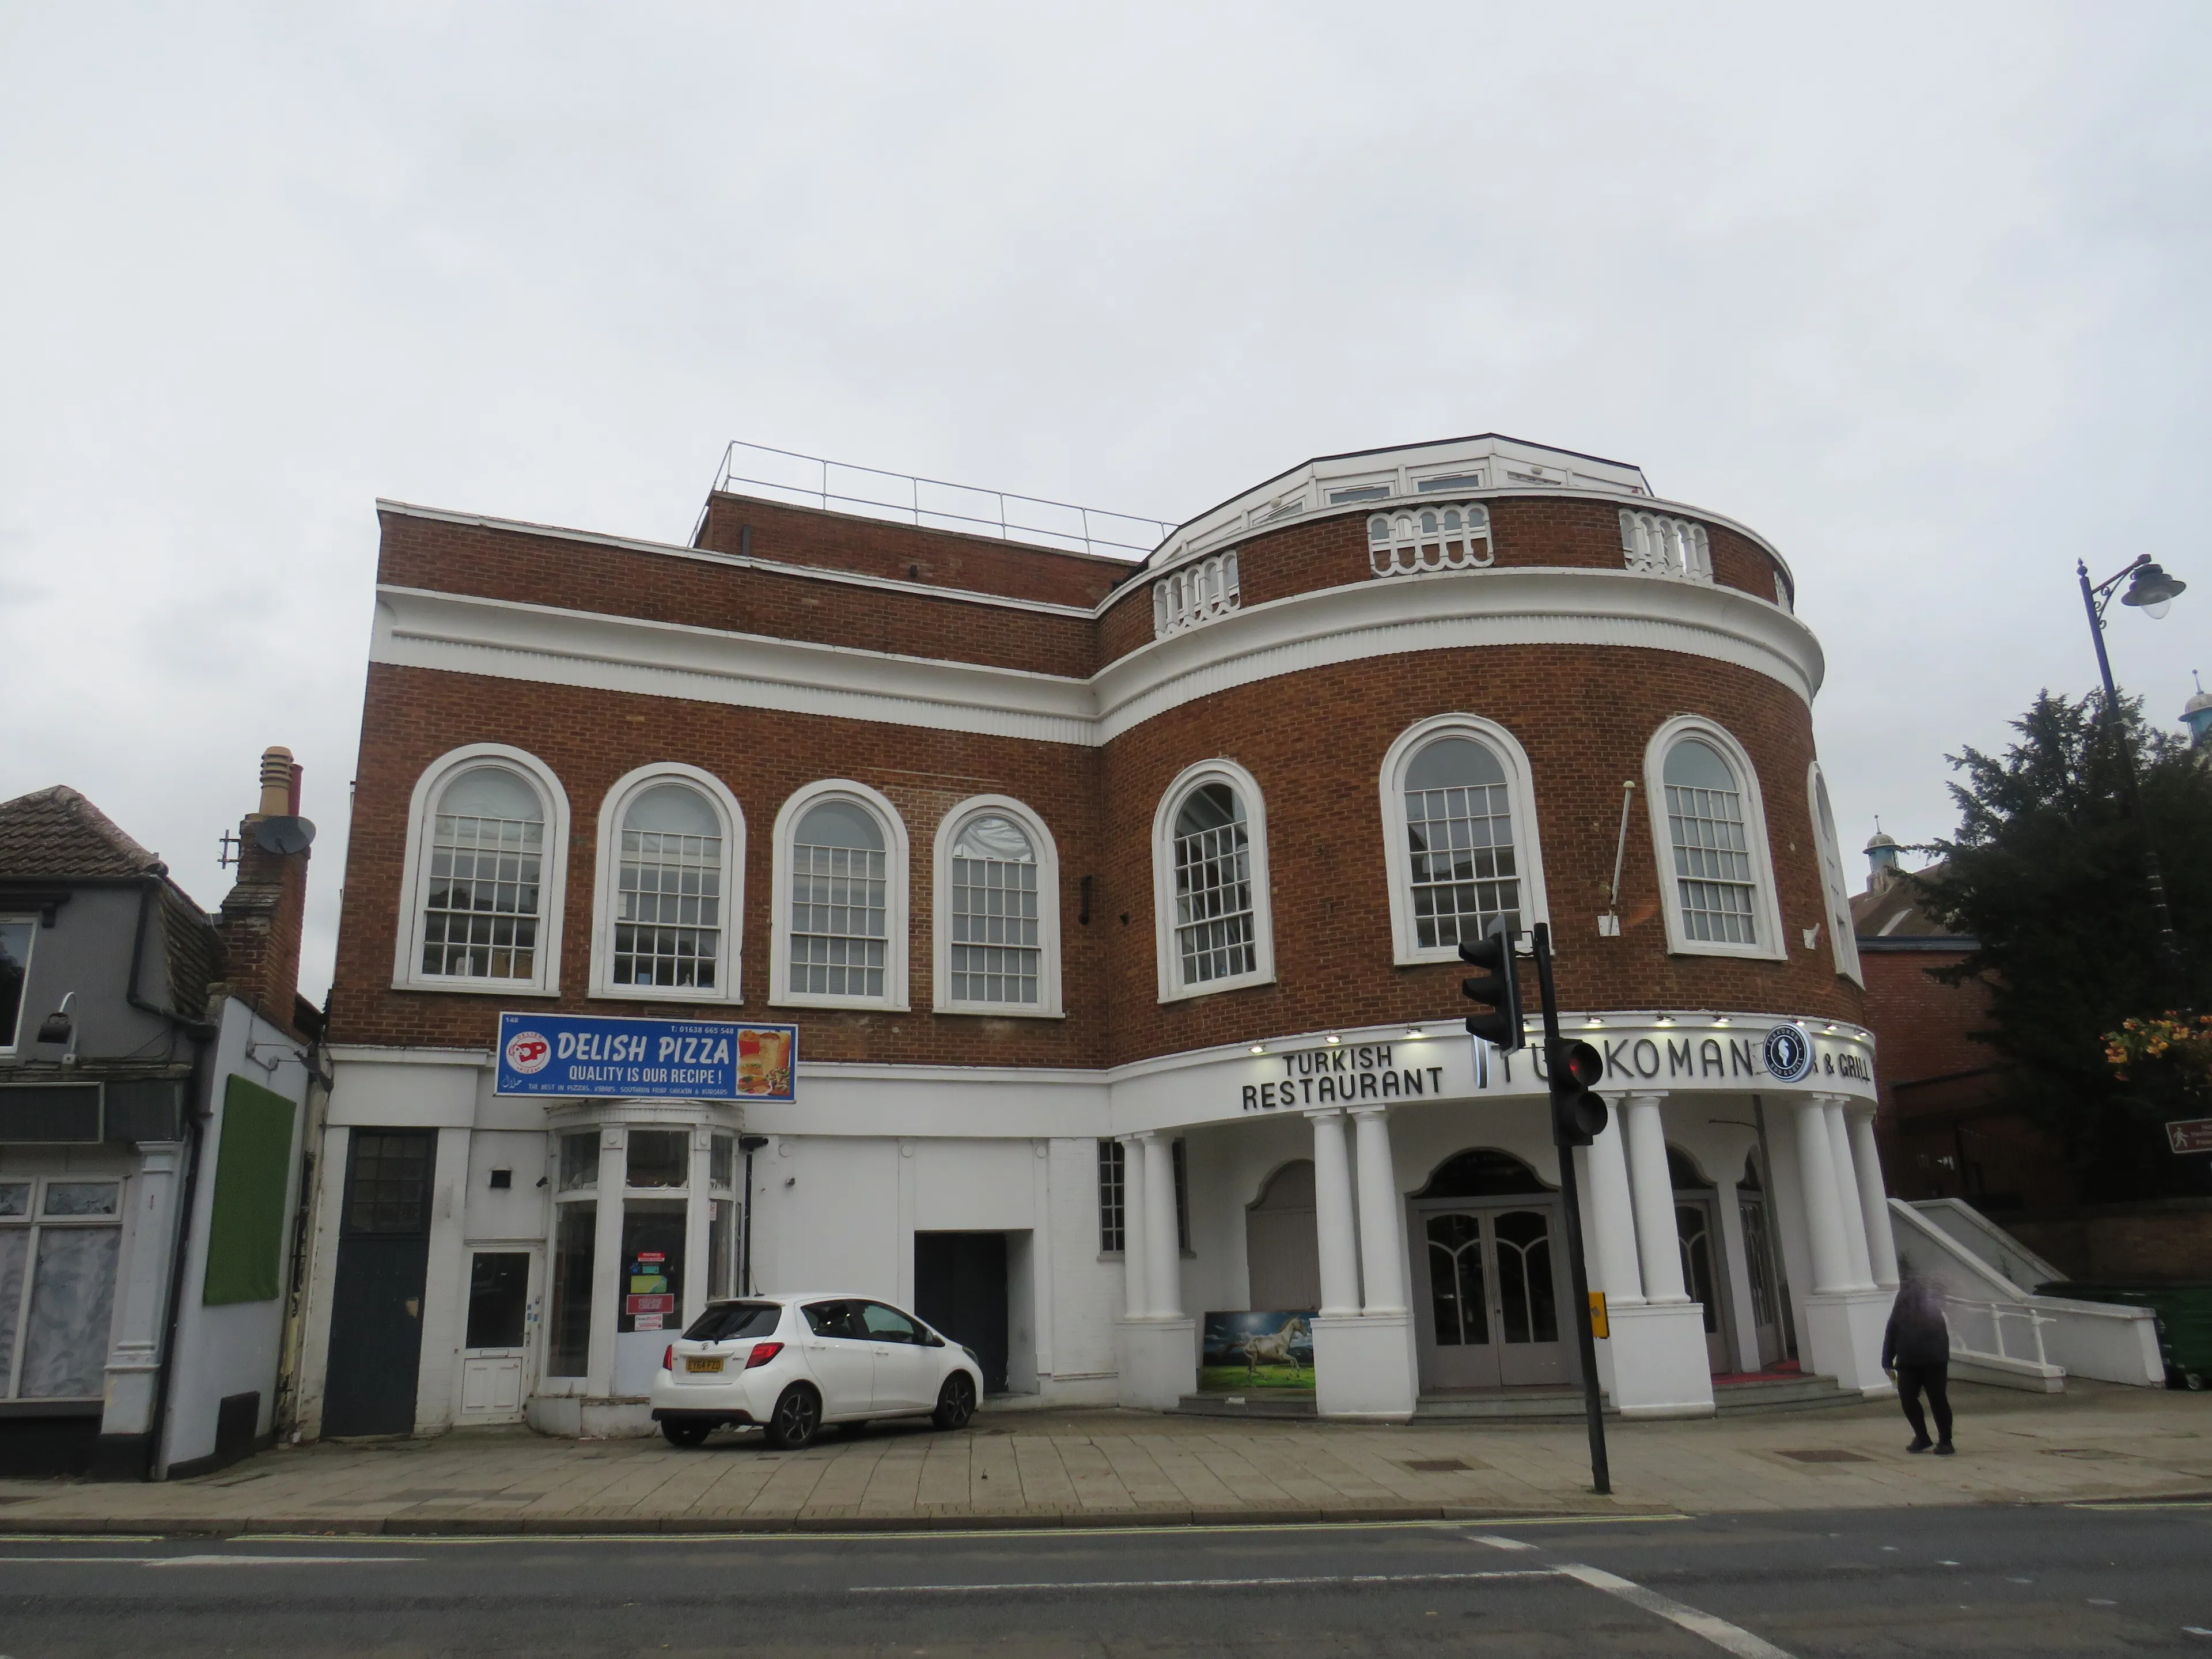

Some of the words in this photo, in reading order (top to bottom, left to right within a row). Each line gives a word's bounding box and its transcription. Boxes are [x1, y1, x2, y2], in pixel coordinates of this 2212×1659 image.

[558, 1032, 647, 1062] DELISH
[659, 1036, 729, 1065] PIZZA
[1283, 1045, 1393, 1077] TURKISH
[1491, 1038, 1755, 1083] TUKOMAN
[569, 1065, 624, 1081] QUALITY
[627, 1067, 639, 1082] IS
[643, 1067, 667, 1083] OUR
[671, 1069, 715, 1084] RECIPE
[1824, 1053, 1835, 1075] &
[1838, 1053, 1871, 1082] GRILL
[1242, 1067, 1443, 1110] RESTAURANT
